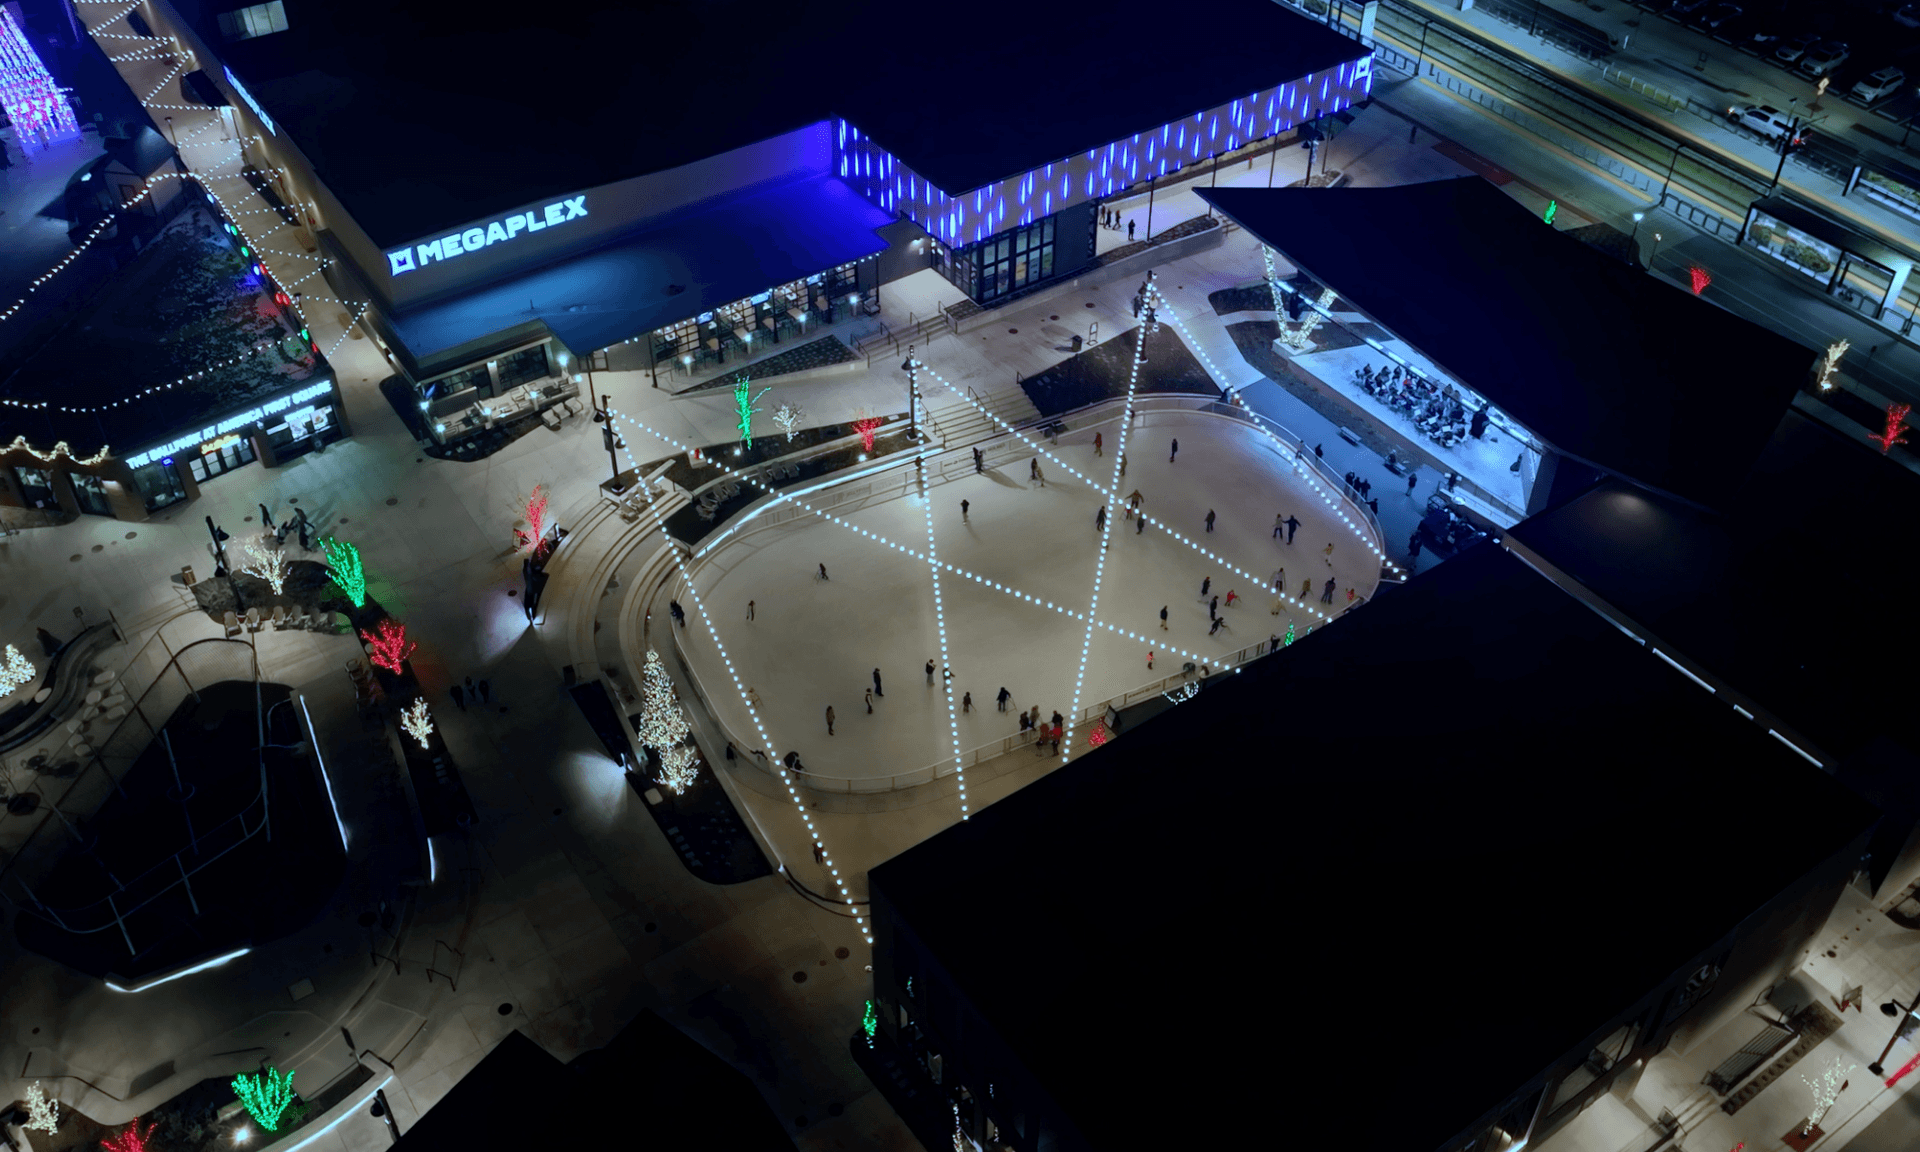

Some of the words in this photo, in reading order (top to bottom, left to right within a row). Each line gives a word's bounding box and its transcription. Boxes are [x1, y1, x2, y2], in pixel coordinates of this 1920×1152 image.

[417, 196, 587, 266] MEGAPLEX
[126, 453, 150, 469] THE
[203, 426, 216, 440] AT
[217, 408, 264, 434] AMERICA
[263, 396, 291, 416] FIRST
[291, 380, 332, 404] SQUARE
